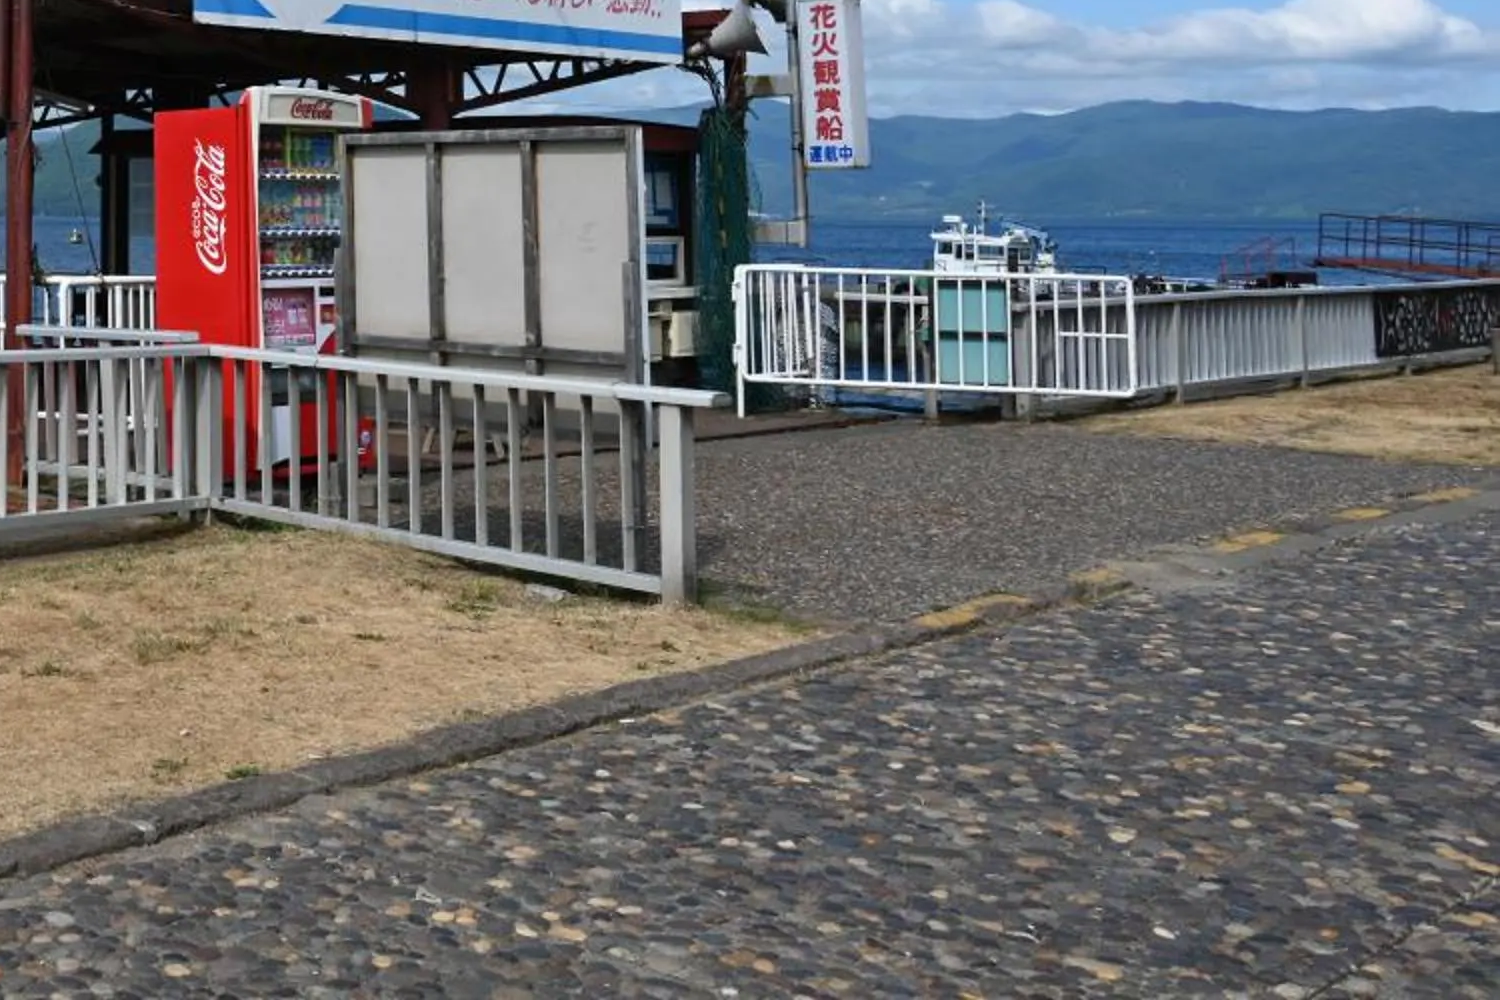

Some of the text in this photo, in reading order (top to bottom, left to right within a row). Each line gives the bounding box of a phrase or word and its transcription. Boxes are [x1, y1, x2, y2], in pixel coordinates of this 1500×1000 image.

[809, 4, 843, 141] 花火観賞船
[194, 136, 228, 275] Coca-Cola
[809, 144, 853, 163] 運航中
